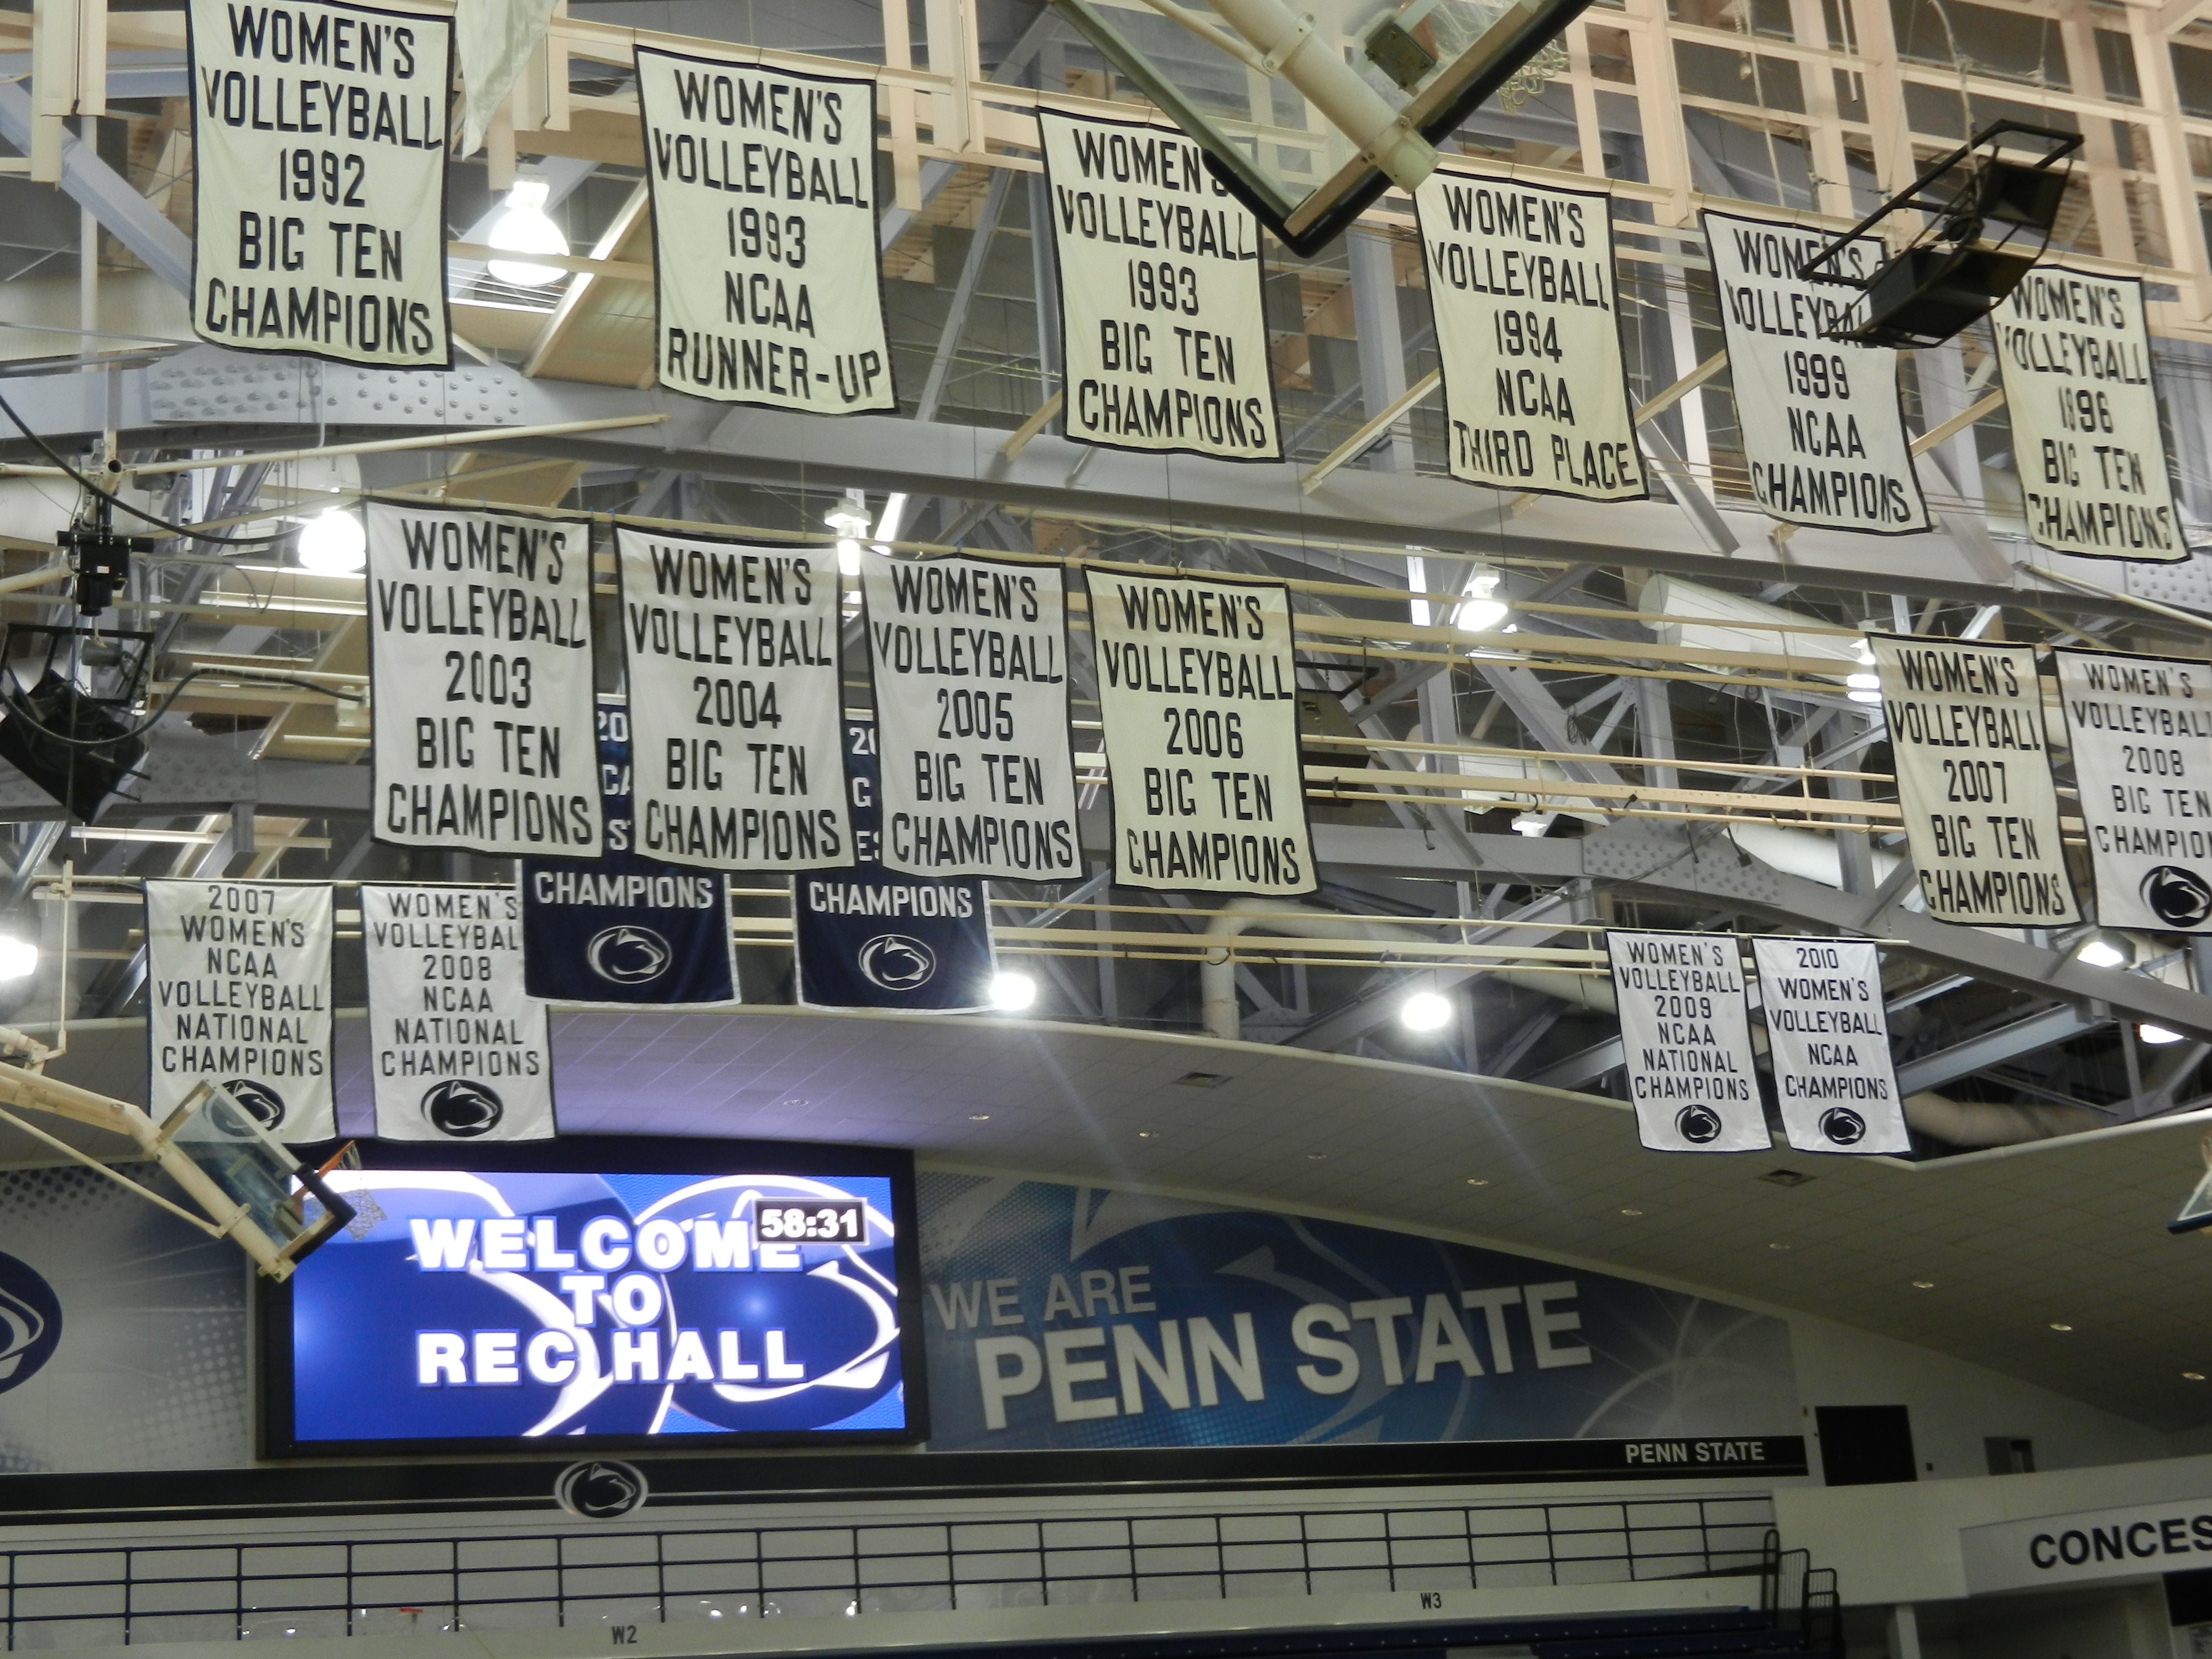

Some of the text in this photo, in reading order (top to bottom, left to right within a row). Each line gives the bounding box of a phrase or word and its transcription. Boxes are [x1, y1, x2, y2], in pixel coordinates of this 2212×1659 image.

[228, 4, 414, 79] WOMEN'S
[201, 67, 442, 150] VOLLEYBALL
[674, 70, 842, 145] WOMEN'S
[280, 149, 366, 207] 1992
[654, 128, 868, 209] VOLLEYBALL
[1073, 128, 1228, 197] WOMEN
[728, 207, 806, 268] 1993
[1057, 185, 1256, 260] VOLLEYBALL
[1442, 184, 1585, 248] WOMEN'S
[239, 211, 403, 281] BIG TEN
[1128, 259, 1198, 315] 1993
[1428, 239, 1609, 311] VOLLEYBALL
[206, 278, 434, 355] CHAMPIONS
[725, 271, 815, 338] NCAA
[2011, 276, 2125, 329] WOMEN'S
[1101, 320, 1235, 384] BIG TEN
[1494, 309, 1562, 363] 1994
[667, 328, 881, 403] RUNNER-UP
[1784, 351, 1850, 400] 1999
[1078, 379, 1266, 448] CHAMPIONS
[1496, 368, 1575, 426] NCAA
[1453, 420, 1637, 489] THIRD PLACE
[1787, 406, 1866, 459] NCAA
[1752, 461, 1911, 524] CHAMPIONS
[2042, 439, 2145, 495] BIG TEN
[401, 519, 566, 585] WOMEN'S
[650, 545, 811, 605] WOMEN'S
[378, 579, 586, 649] VOLLEYBALL
[890, 565, 1038, 622] WOMEN'S
[1117, 584, 1264, 640] WOMEN'S
[629, 603, 832, 667] VOLLEYBALL
[874, 622, 1063, 684] VOLLEYBALL
[445, 650, 531, 708] 2003
[1102, 639, 1292, 700] VOLLEYBALL
[1896, 649, 2019, 697] WOMEN'S
[2083, 663, 2193, 698] WOMEN'S
[693, 677, 781, 729] 2004
[937, 688, 1013, 741] 2005
[1888, 700, 2041, 751] VOLLEYBALL
[416, 717, 561, 779] BIG TEN
[1164, 708, 1243, 758] 2006
[667, 738, 722, 791] BIG
[747, 743, 807, 796] TEN
[915, 752, 964, 802] BIG
[981, 754, 1044, 805] TEN
[1943, 760, 2007, 804] 2007
[2122, 745, 2185, 776] 2008
[389, 783, 592, 844] CHAMPIONS
[1144, 768, 1272, 822] BIG TEN
[2112, 785, 2212, 818] BIG TEN
[646, 799, 840, 860] CHAMPIONS
[891, 813, 1073, 870] CHAMPIONS
[1931, 815, 2040, 860] BIG TEN
[2095, 826, 2212, 859] CHAMPIO
[1127, 828, 1300, 885] CHAMPIONS
[208, 885, 275, 915] 2007
[388, 892, 517, 920] WOMEN'S
[534, 871, 714, 910] CHAMPIONS
[809, 881, 973, 919] CHAMPIONS
[1919, 869, 2065, 915] CHAMPIONS
[181, 915, 305, 948] WOMEN'S
[373, 921, 519, 951] VOLLEYBAL
[1627, 941, 1723, 967] WOMEN'S
[1796, 947, 1838, 969] 2010
[207, 947, 278, 978] NCAA
[423, 954, 492, 981] 2008
[1619, 967, 1740, 993] VOLLEYBALL
[1777, 977, 1869, 1001] WOMEN'S
[159, 979, 324, 1011] VOLLEYBALL
[424, 986, 493, 1013] NCAA
[1655, 996, 1712, 1019] 2009
[178, 1013, 309, 1044] NATIONAL
[395, 1018, 524, 1045] NATIONAL
[1657, 1022, 1716, 1046] NCAA
[1770, 1010, 1882, 1036] VOLLEYBALL
[163, 1046, 323, 1076] CHAMPIONS
[382, 1050, 540, 1077] CHAMPIONS
[1642, 1049, 1738, 1073] NATIONAL
[1808, 1044, 1858, 1067] NCAA
[1635, 1076, 1750, 1100] CHAMPIONS
[1785, 1074, 1888, 1100] CHAMPIONS
[761, 1208, 857, 1238] 58:31
[562, 1274, 661, 1326] TO
[931, 1266, 1156, 1330] WE ARE
[419, 1331, 805, 1384] REC HALL
[975, 1280, 1592, 1431] PENN STATE
[1625, 1442, 1765, 1463] PENN STATE
[1421, 1593, 1442, 1609] W3
[612, 1625, 638, 1644] W2
